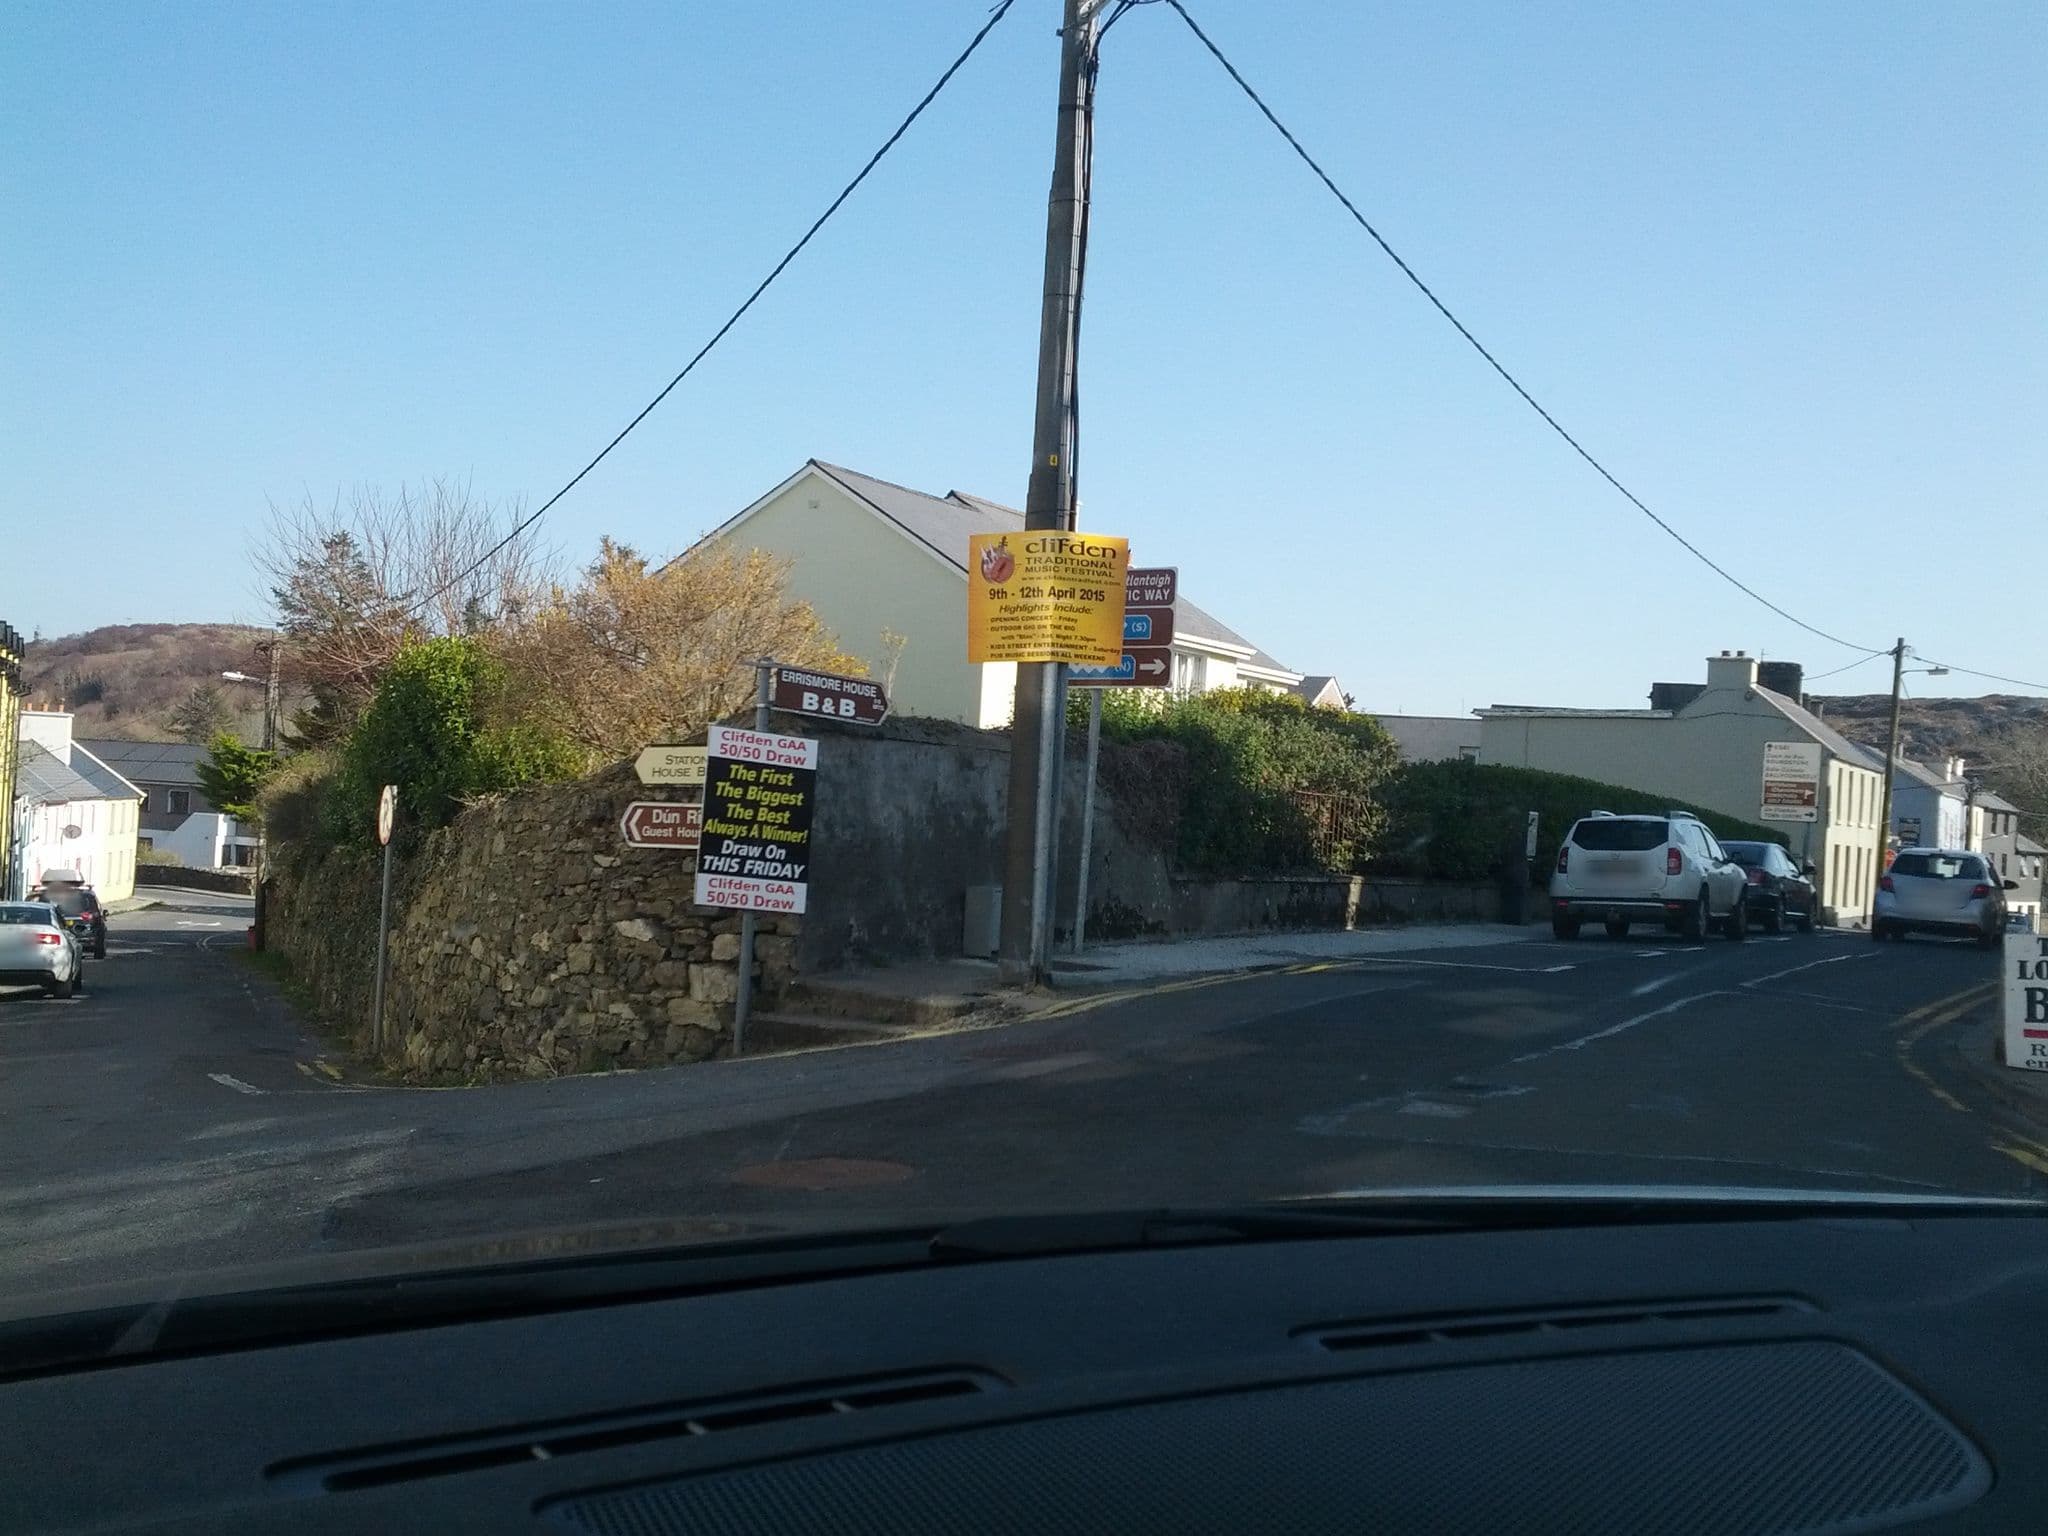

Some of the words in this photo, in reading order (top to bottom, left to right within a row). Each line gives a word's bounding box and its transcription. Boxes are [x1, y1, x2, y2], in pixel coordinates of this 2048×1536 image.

[1024, 565, 1060, 573] MUSIC
[1064, 566, 1115, 578] FESTIVAL
[1025, 556, 1116, 570] TRADITIONAL
[1126, 574, 1170, 587] tlantaigh
[989, 588, 1008, 600] 9th
[1019, 586, 1043, 598] 12th
[1048, 585, 1075, 601] April
[1079, 588, 1105, 602] 2015
[1144, 588, 1170, 601] WAY
[999, 603, 1050, 615] Highlights
[1053, 603, 1094, 615] Include:
[1058, 615, 1078, 624] Friday
[1131, 621, 1147, 633] (S)
[1033, 642, 1088, 651] ENTERTAINMENT
[1073, 653, 1106, 661] WEEKEND
[781, 670, 842, 691] ERRISMORE
[842, 681, 877, 698] HOUSE
[802, 691, 819, 711] B
[821, 697, 836, 714] &
[838, 698, 856, 717] B
[721, 730, 772, 746] Clifden
[777, 738, 807, 751] GAA
[719, 743, 761, 760] 50/50
[766, 749, 807, 766] Draw
[652, 767, 691, 777] HOUSE
[729, 764, 757, 781] The
[760, 768, 794, 786] First
[715, 781, 743, 799] The
[745, 785, 804, 807] Biggest
[652, 808, 680, 824] Dún
[726, 802, 754, 820] The
[757, 806, 791, 824] Best
[641, 825, 673, 837] Guest
[676, 826, 701, 838] Hou
[703, 818, 749, 840] Always
[748, 823, 759, 839] A
[761, 824, 809, 844] Winner!
[721, 839, 763, 858] Draw
[765, 844, 787, 860] On
[703, 855, 741, 873] THIS
[743, 859, 805, 879] FRIDAY
[708, 878, 760, 892] Clifden
[765, 882, 795, 896] GAA
[706, 890, 749, 906] 50/50
[753, 895, 795, 910] Draw
